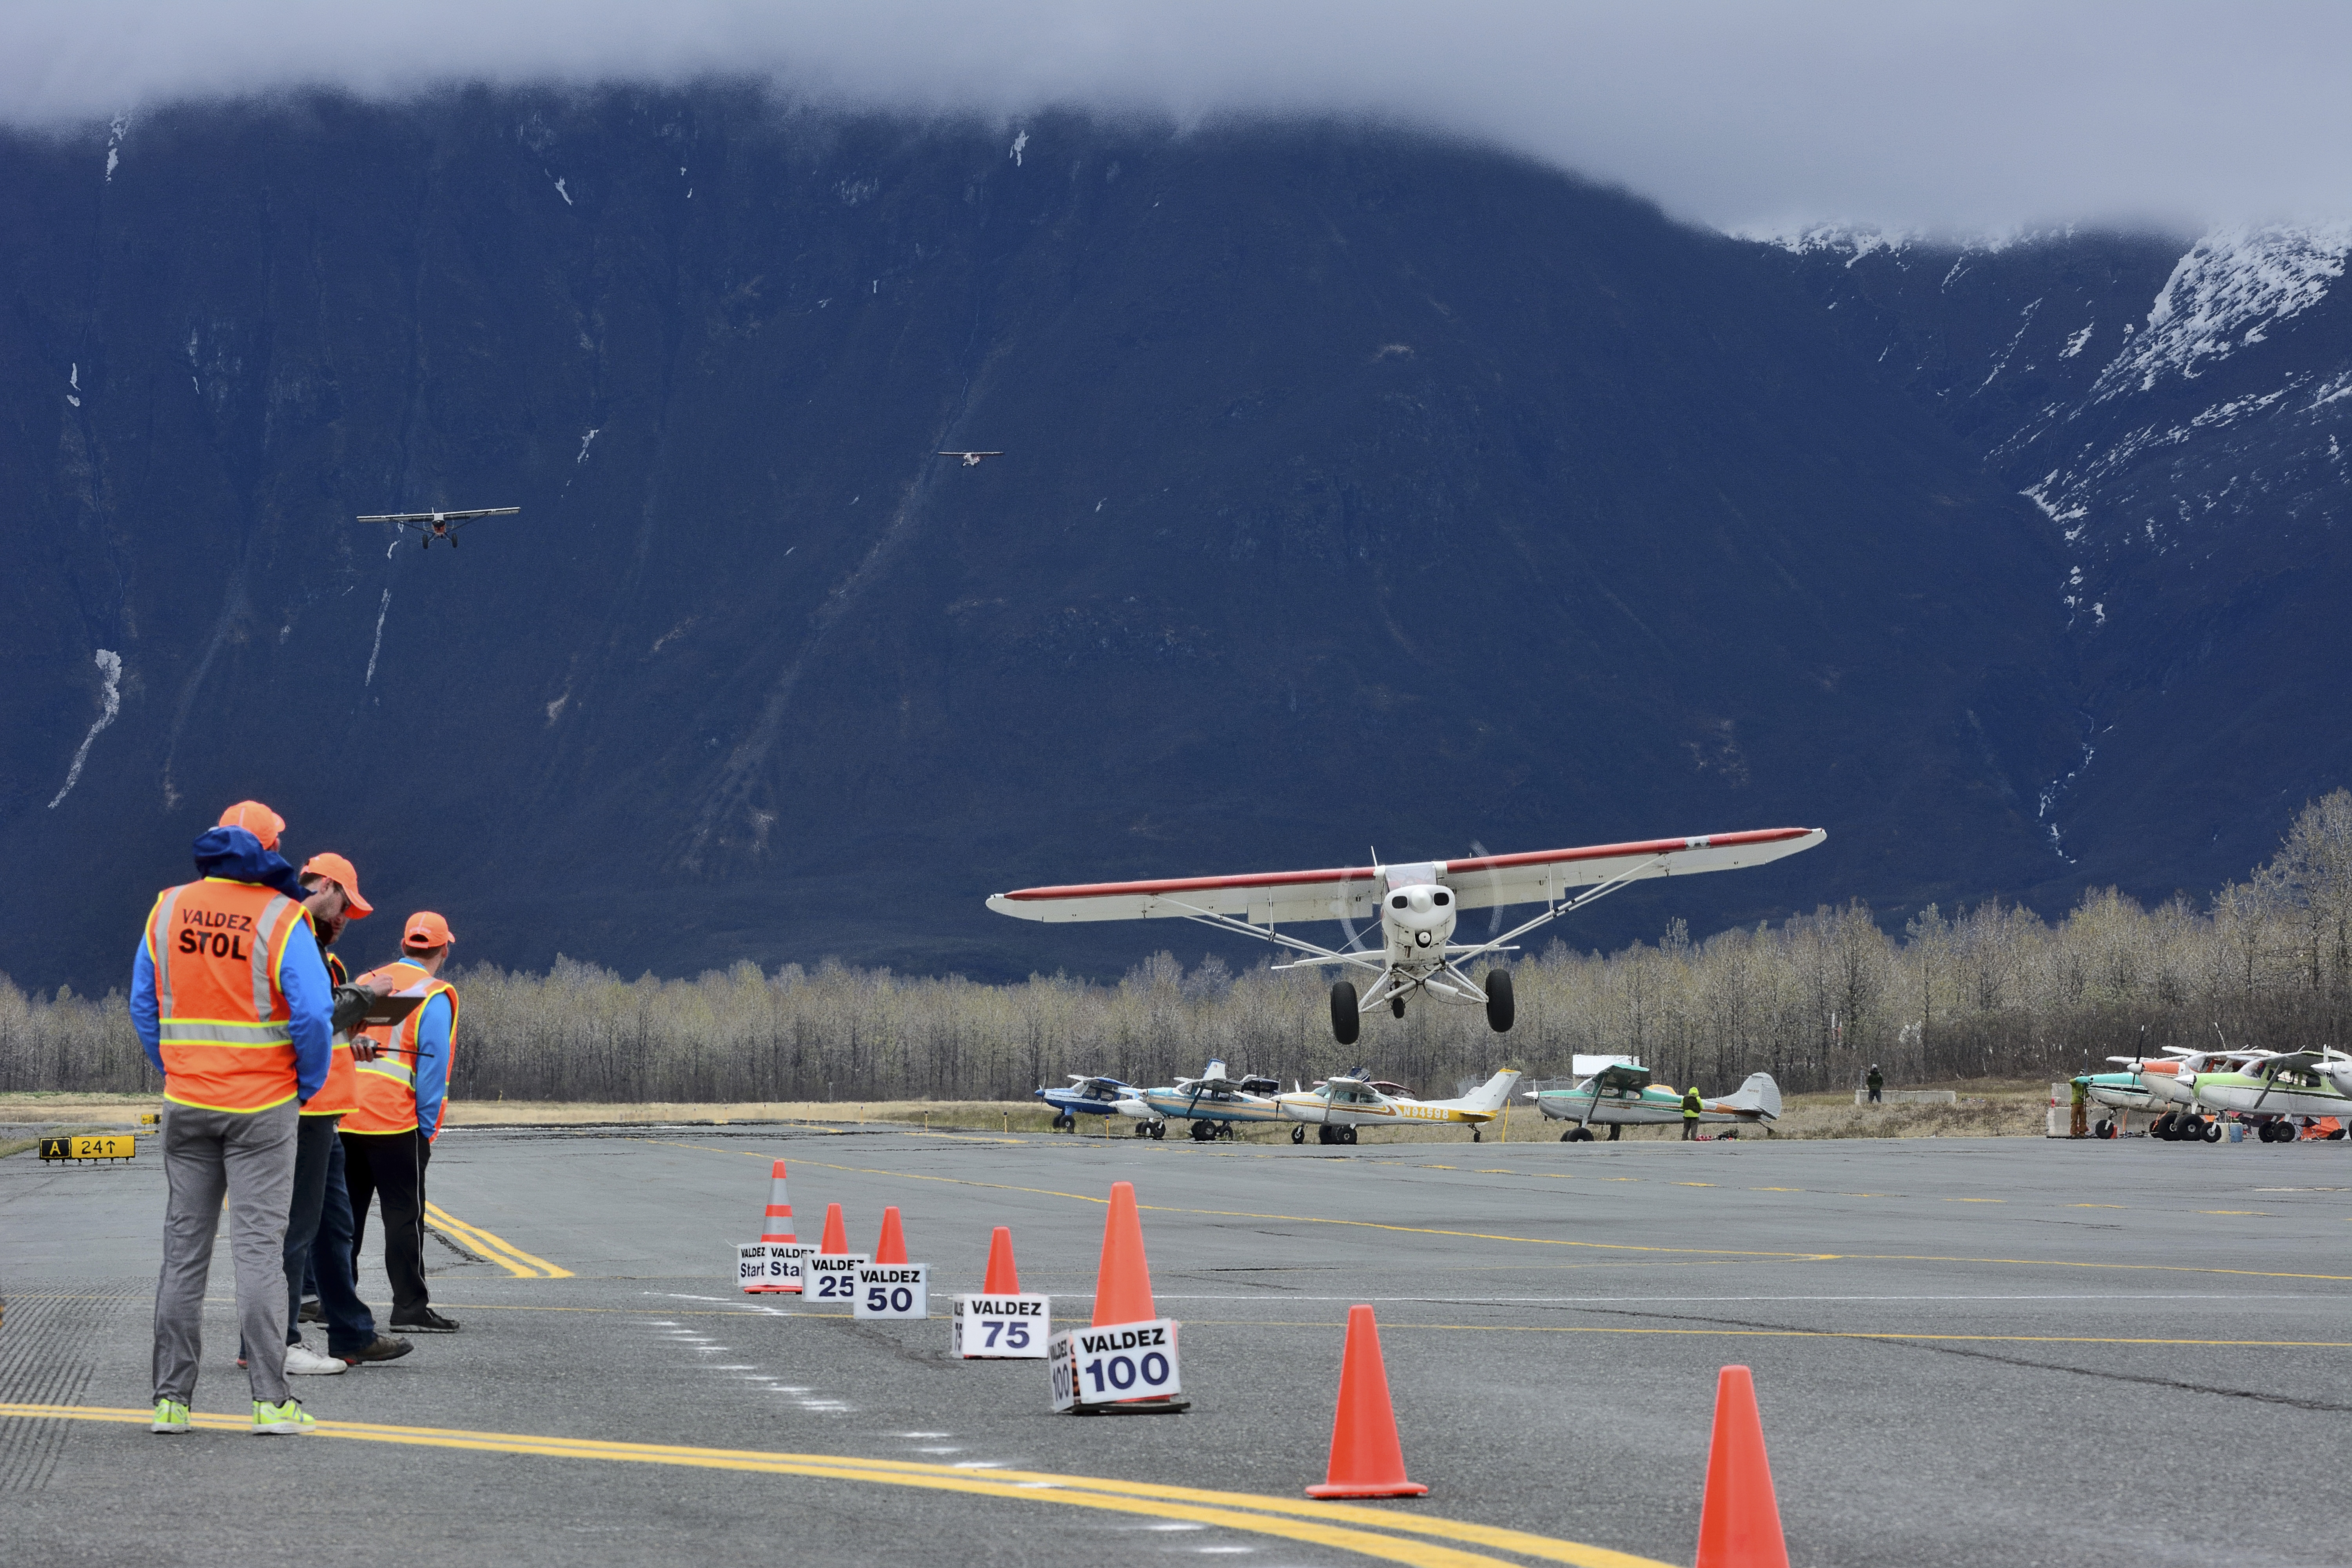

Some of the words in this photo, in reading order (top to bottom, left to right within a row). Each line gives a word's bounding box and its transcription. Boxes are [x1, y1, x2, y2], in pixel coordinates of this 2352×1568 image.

[183, 909, 252, 932] VALDEZ
[179, 929, 247, 961] STOL
[50, 1141, 61, 1155] A
[82, 1140, 102, 1154] 24
[741, 1247, 765, 1258] VALDEZ
[740, 1262, 764, 1278] Start
[771, 1261, 802, 1276] Sta
[860, 1270, 920, 1283] VALDEZ
[819, 1276, 853, 1297] 25
[867, 1287, 912, 1312] 50
[972, 1301, 1041, 1316] VALDEZ
[982, 1321, 1030, 1348] 75
[1082, 1328, 1165, 1353] VALDEZ
[1053, 1364, 1069, 1401] 100
[1086, 1352, 1169, 1392] 100
